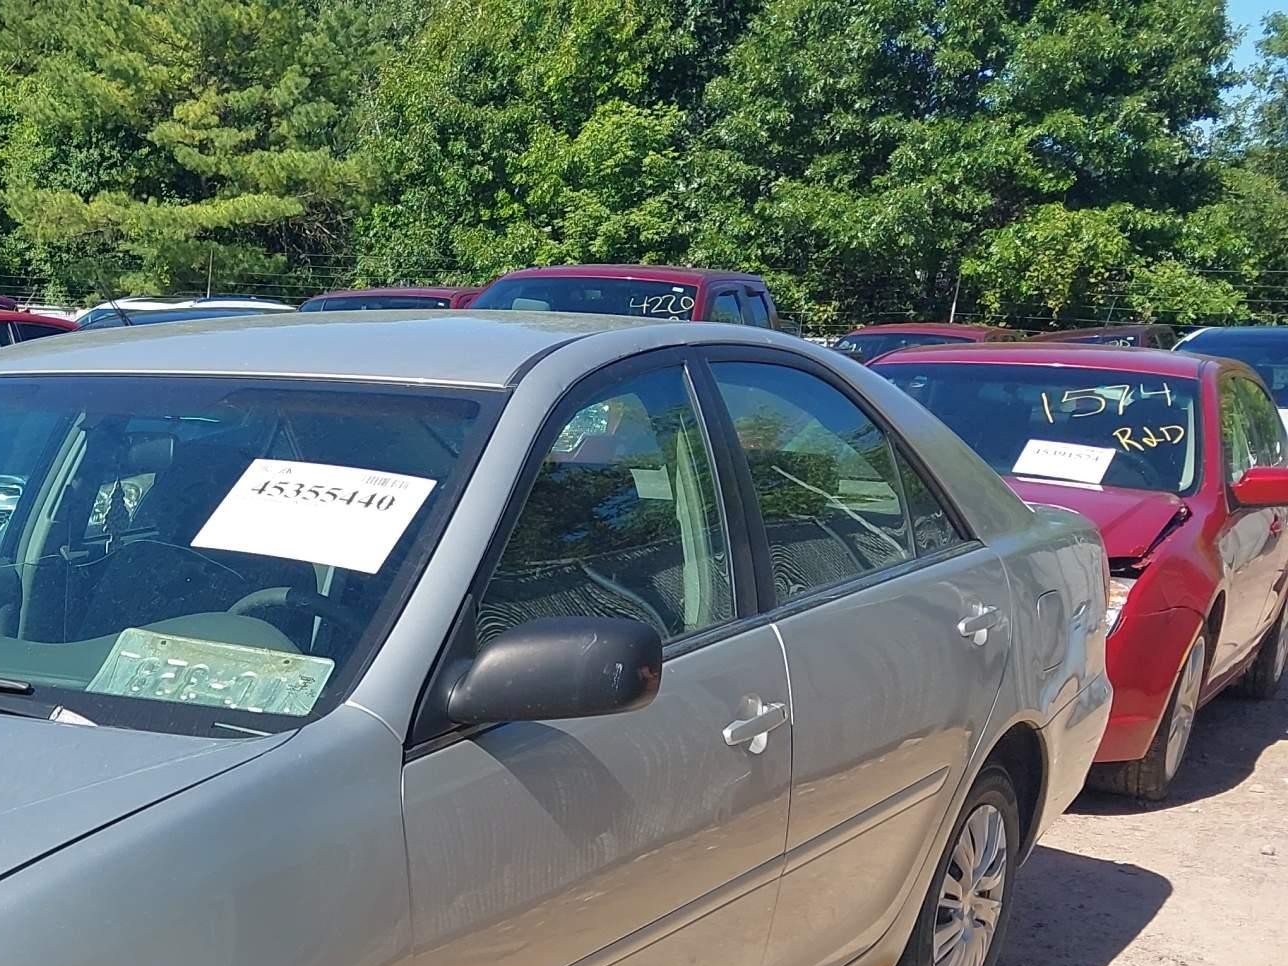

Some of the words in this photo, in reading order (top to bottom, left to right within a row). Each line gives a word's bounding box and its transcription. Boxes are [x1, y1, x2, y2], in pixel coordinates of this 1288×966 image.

[629, 294, 695, 314] 4220
[1041, 382, 1172, 424] 1574
[251, 480, 396, 511] 45355440
